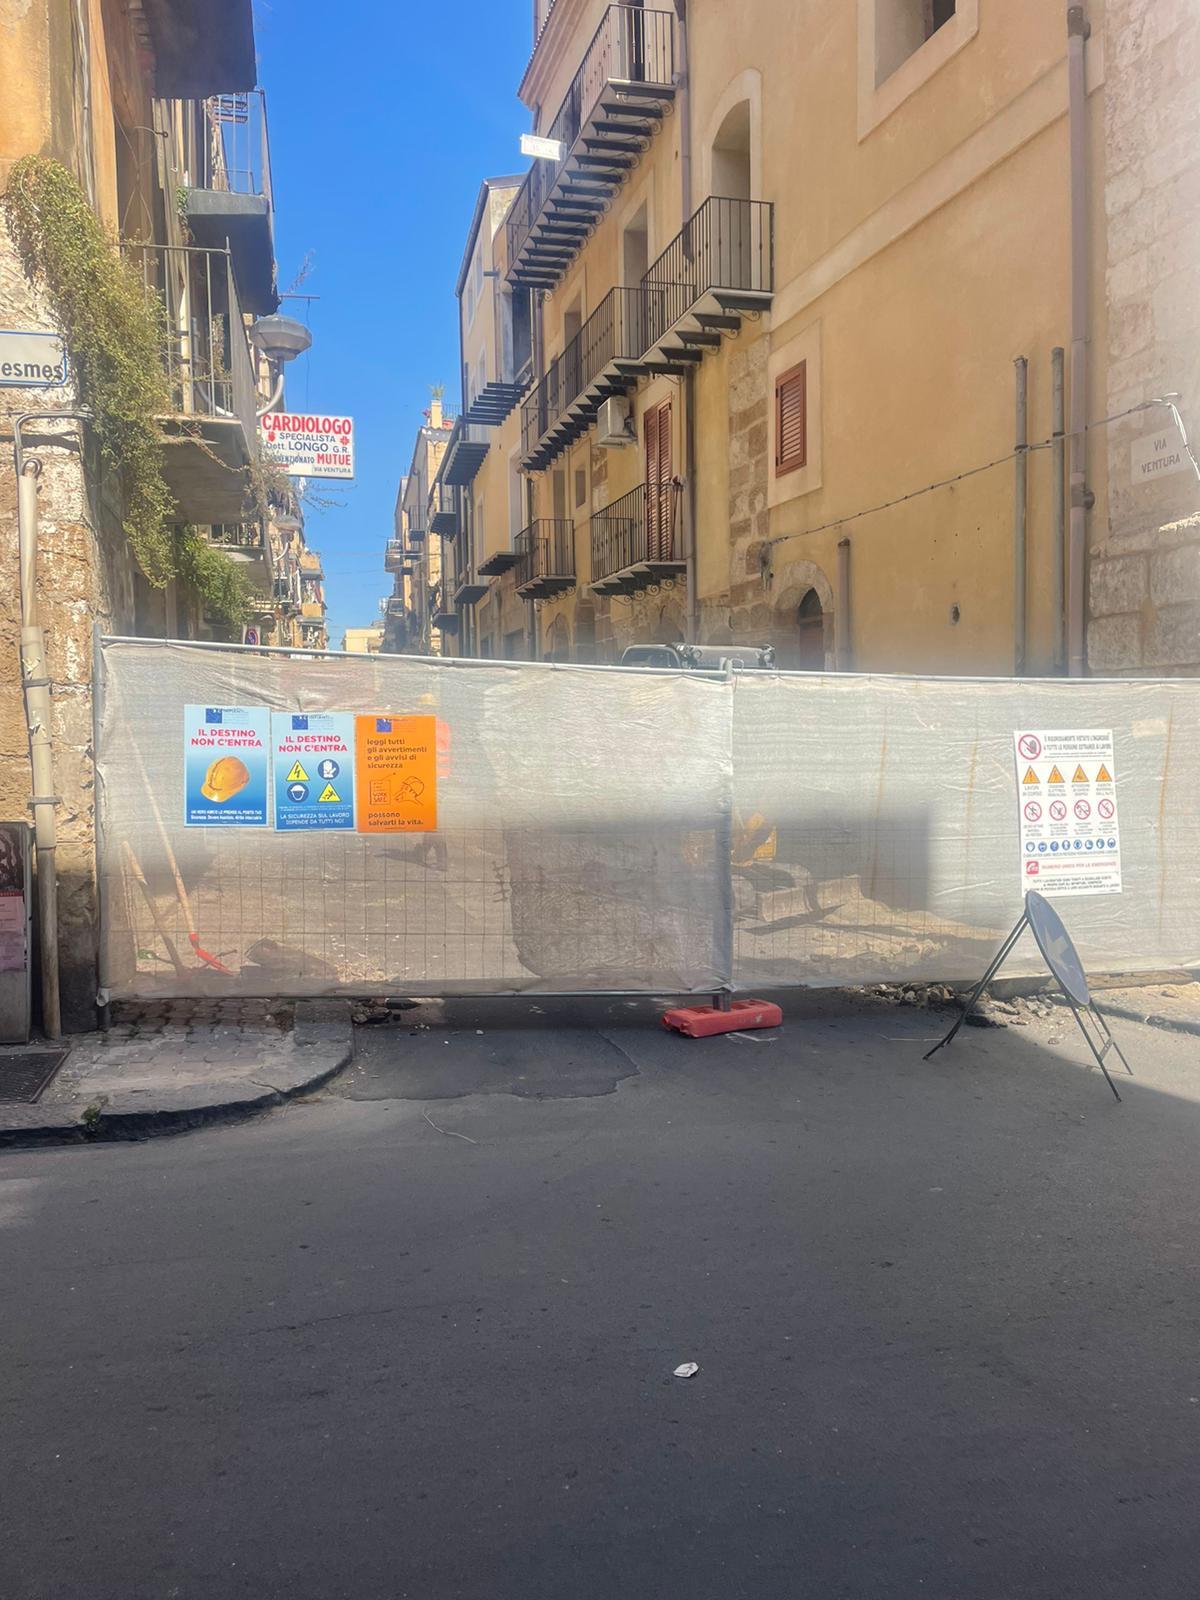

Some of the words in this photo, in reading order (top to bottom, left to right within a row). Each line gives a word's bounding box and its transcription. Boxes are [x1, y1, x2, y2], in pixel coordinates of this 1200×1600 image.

[262, 414, 351, 434] CARDIOLOGO
[279, 432, 336, 442] SPECIALISTA
[288, 441, 328, 452] LONGO
[1153, 437, 1167, 452] VIA
[317, 453, 351, 465] MUTUE
[1141, 453, 1180, 473] VENTURA
[198, 728, 207, 736] IL
[210, 729, 256, 737] DESTINO
[191, 738, 215, 746] NON
[217, 739, 262, 747] C'ENTRA
[297, 735, 341, 743] DESTINO
[304, 744, 347, 752] C'ENTRA
[367, 746, 377, 754] gli
[373, 754, 384, 762] gli
[407, 817, 423, 825] vita.
